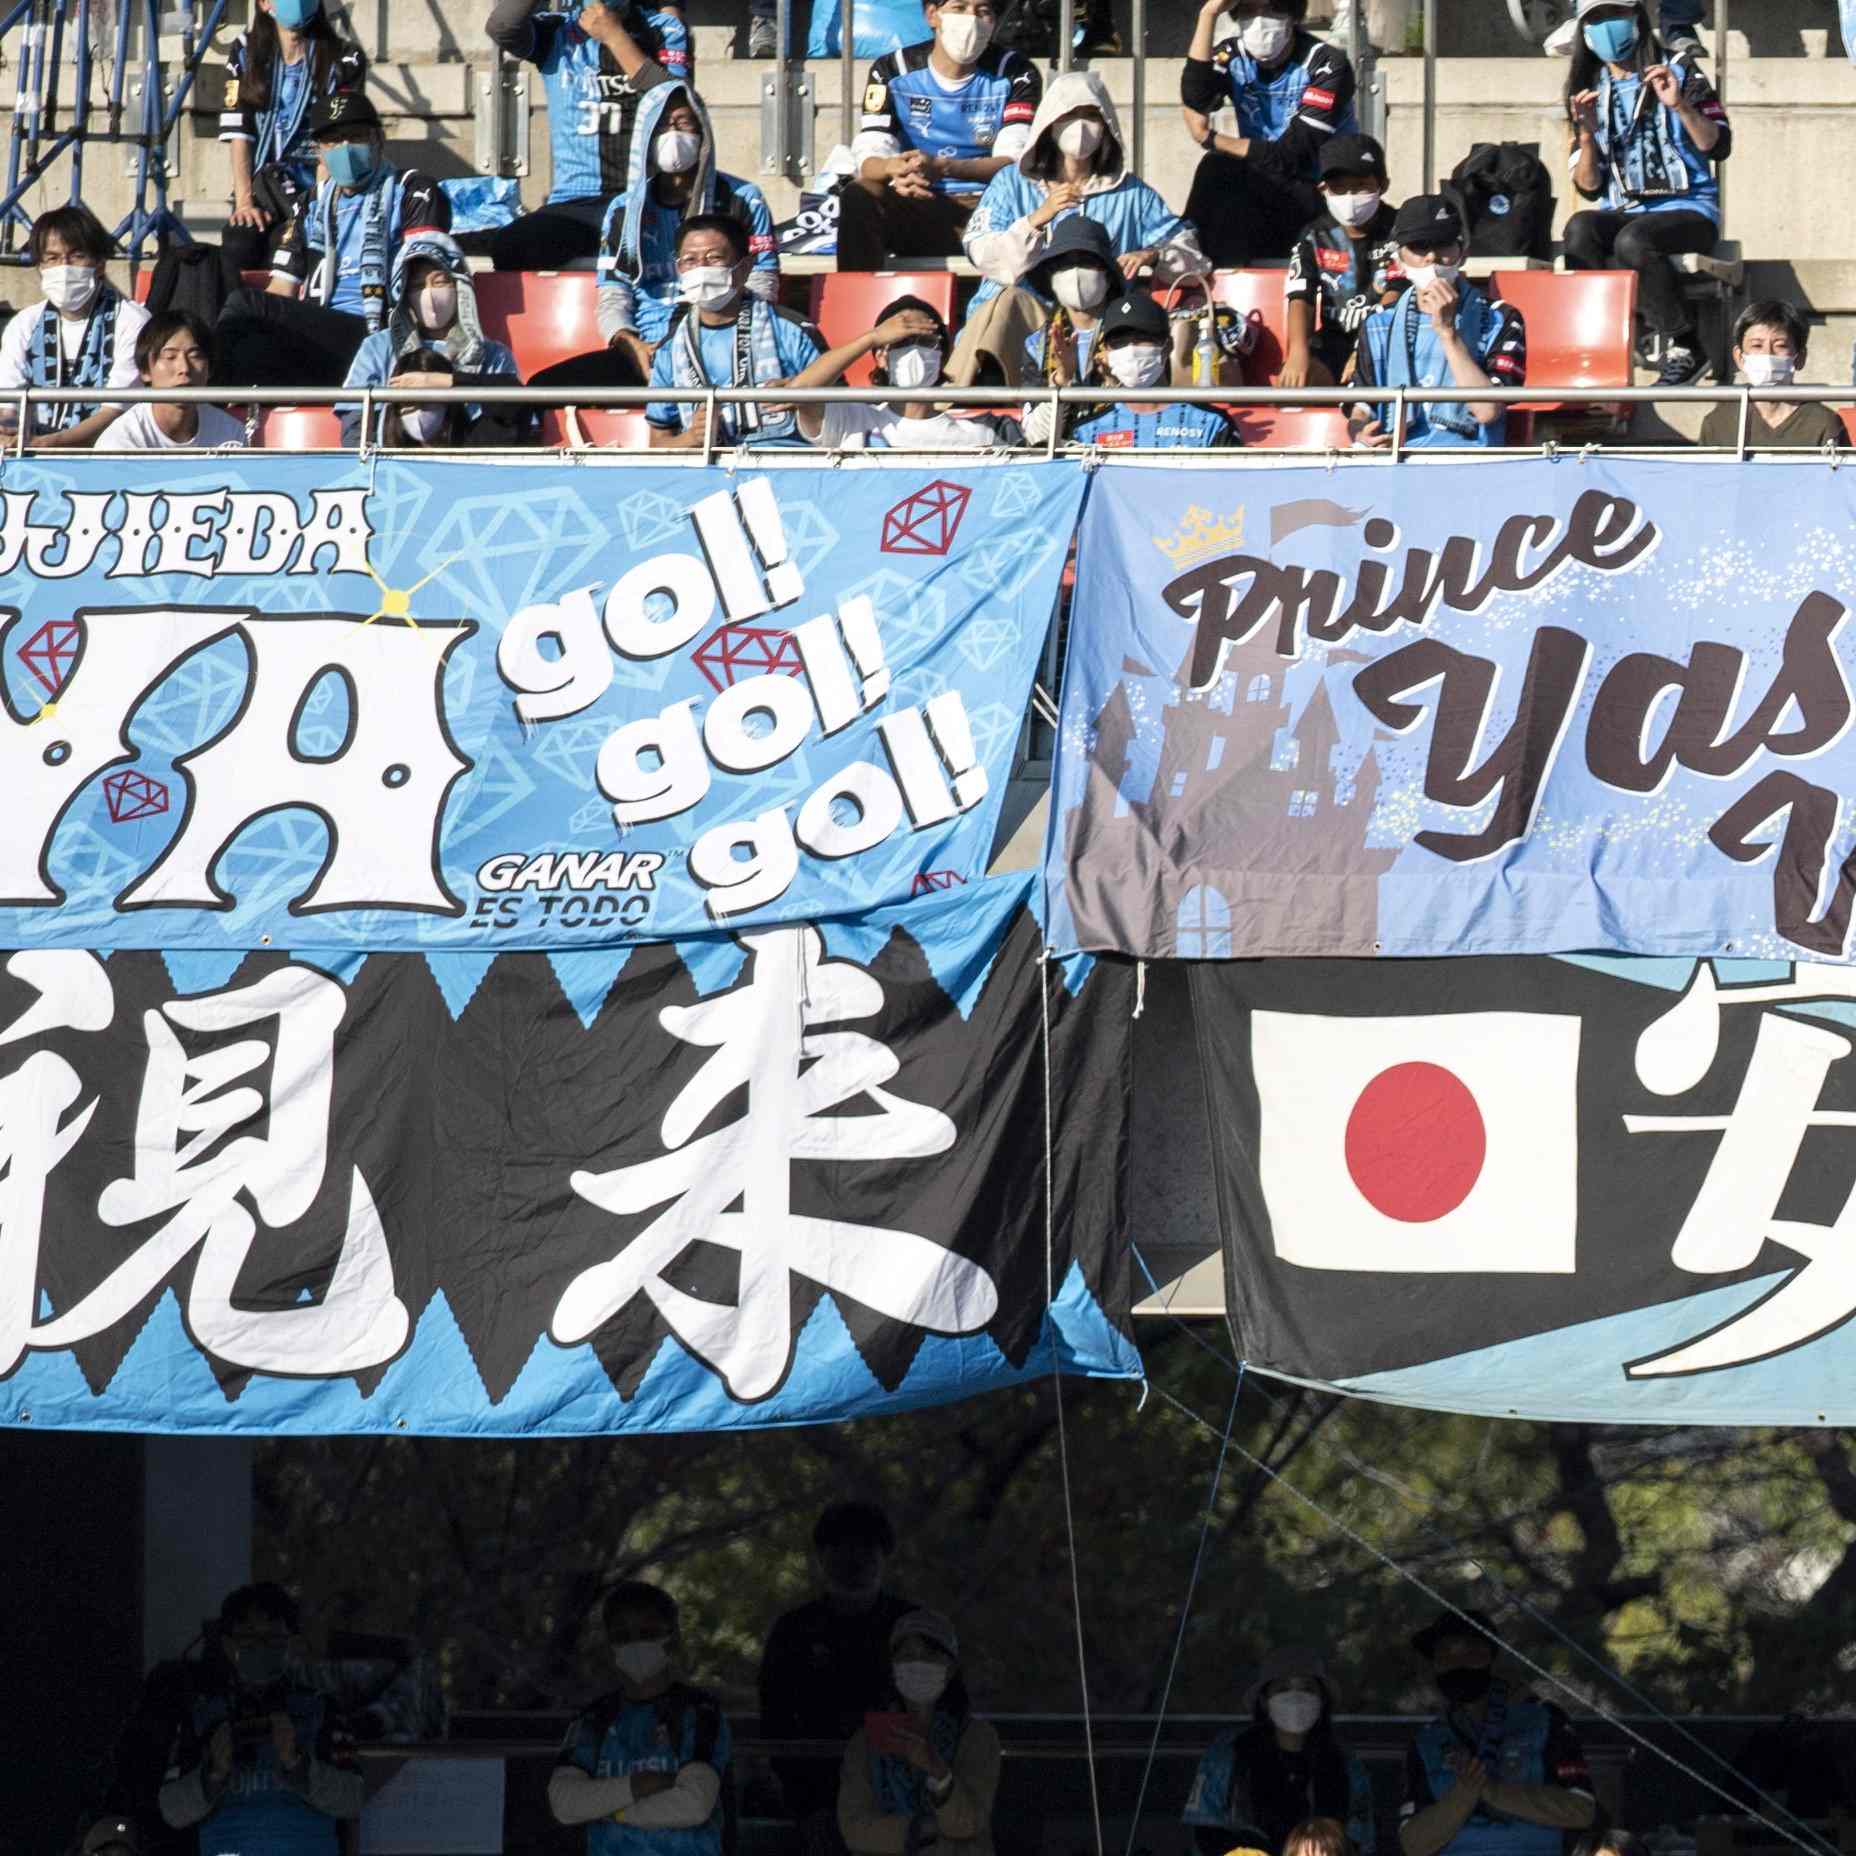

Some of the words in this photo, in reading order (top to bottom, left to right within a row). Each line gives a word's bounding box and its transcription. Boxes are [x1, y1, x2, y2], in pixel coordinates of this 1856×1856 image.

[577, 101, 623, 136] 37
[1156, 425, 1204, 438] RENOSY
[496, 477, 804, 740] gol!
[1160, 486, 1660, 692] Prince
[595, 594, 892, 840] gol!
[687, 690, 989, 922] gol!
[468, 896, 520, 929] ES
[536, 896, 651, 928] TODO
[476, 849, 665, 893] GANAR
